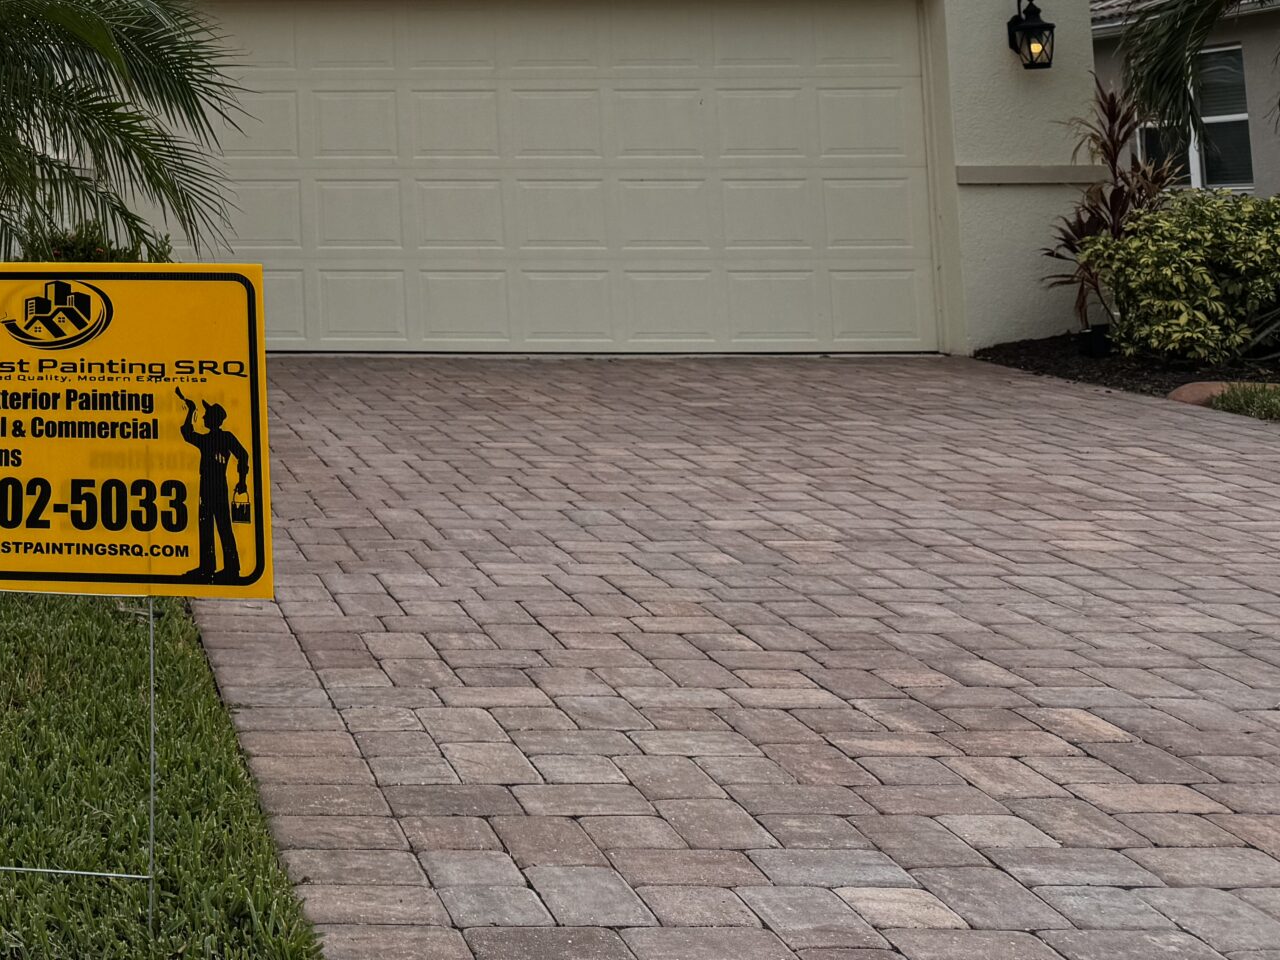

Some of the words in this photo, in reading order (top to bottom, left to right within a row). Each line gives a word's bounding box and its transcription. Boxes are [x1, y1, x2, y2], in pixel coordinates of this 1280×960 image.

[17, 373, 72, 383] Quality,
[77, 375, 131, 383] Modern
[136, 375, 208, 384] Expertise
[38, 357, 166, 378] Painting
[175, 360, 248, 378] SRQ
[65, 388, 154, 415] Painting
[11, 419, 26, 439] &
[30, 416, 159, 440] Commercial
